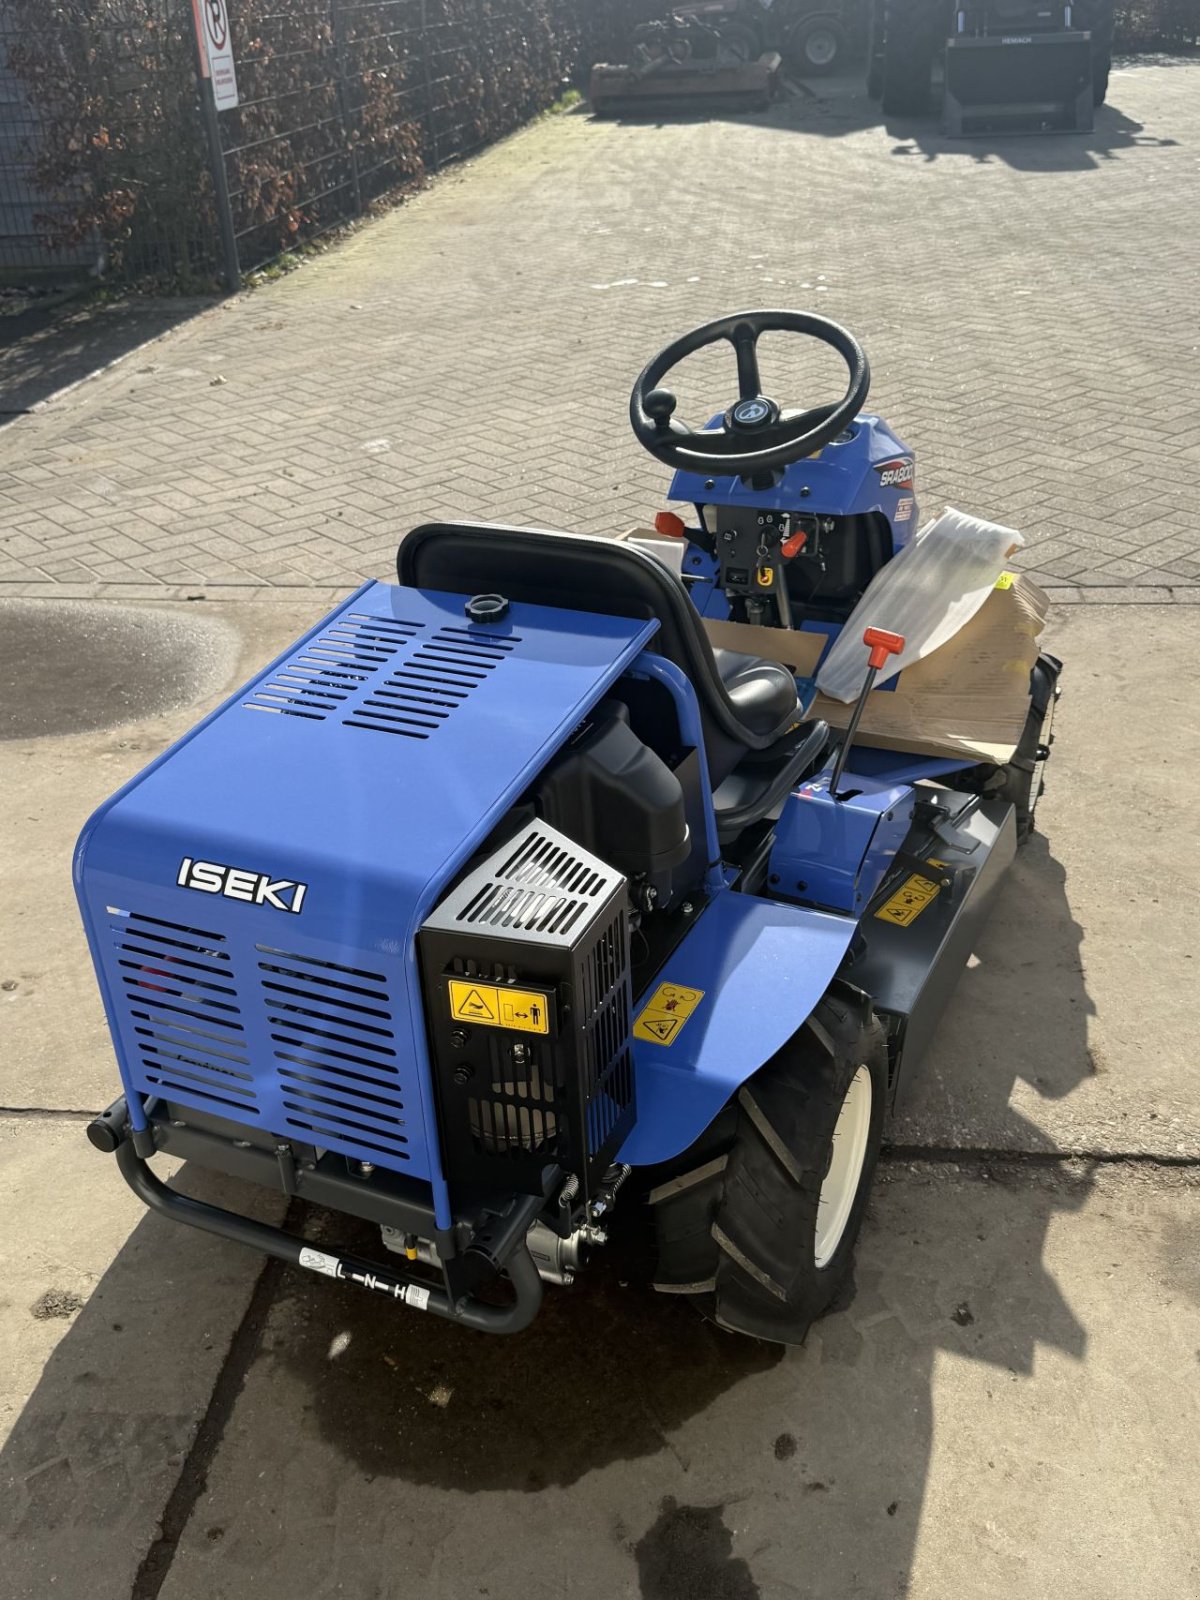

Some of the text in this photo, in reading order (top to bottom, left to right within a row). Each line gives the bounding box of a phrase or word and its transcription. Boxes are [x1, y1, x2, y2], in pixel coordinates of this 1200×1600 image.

[177, 857, 307, 914] ISEKI
[337, 1264, 346, 1279] L
[364, 1273, 376, 1289] N
[394, 1284, 406, 1300] H
